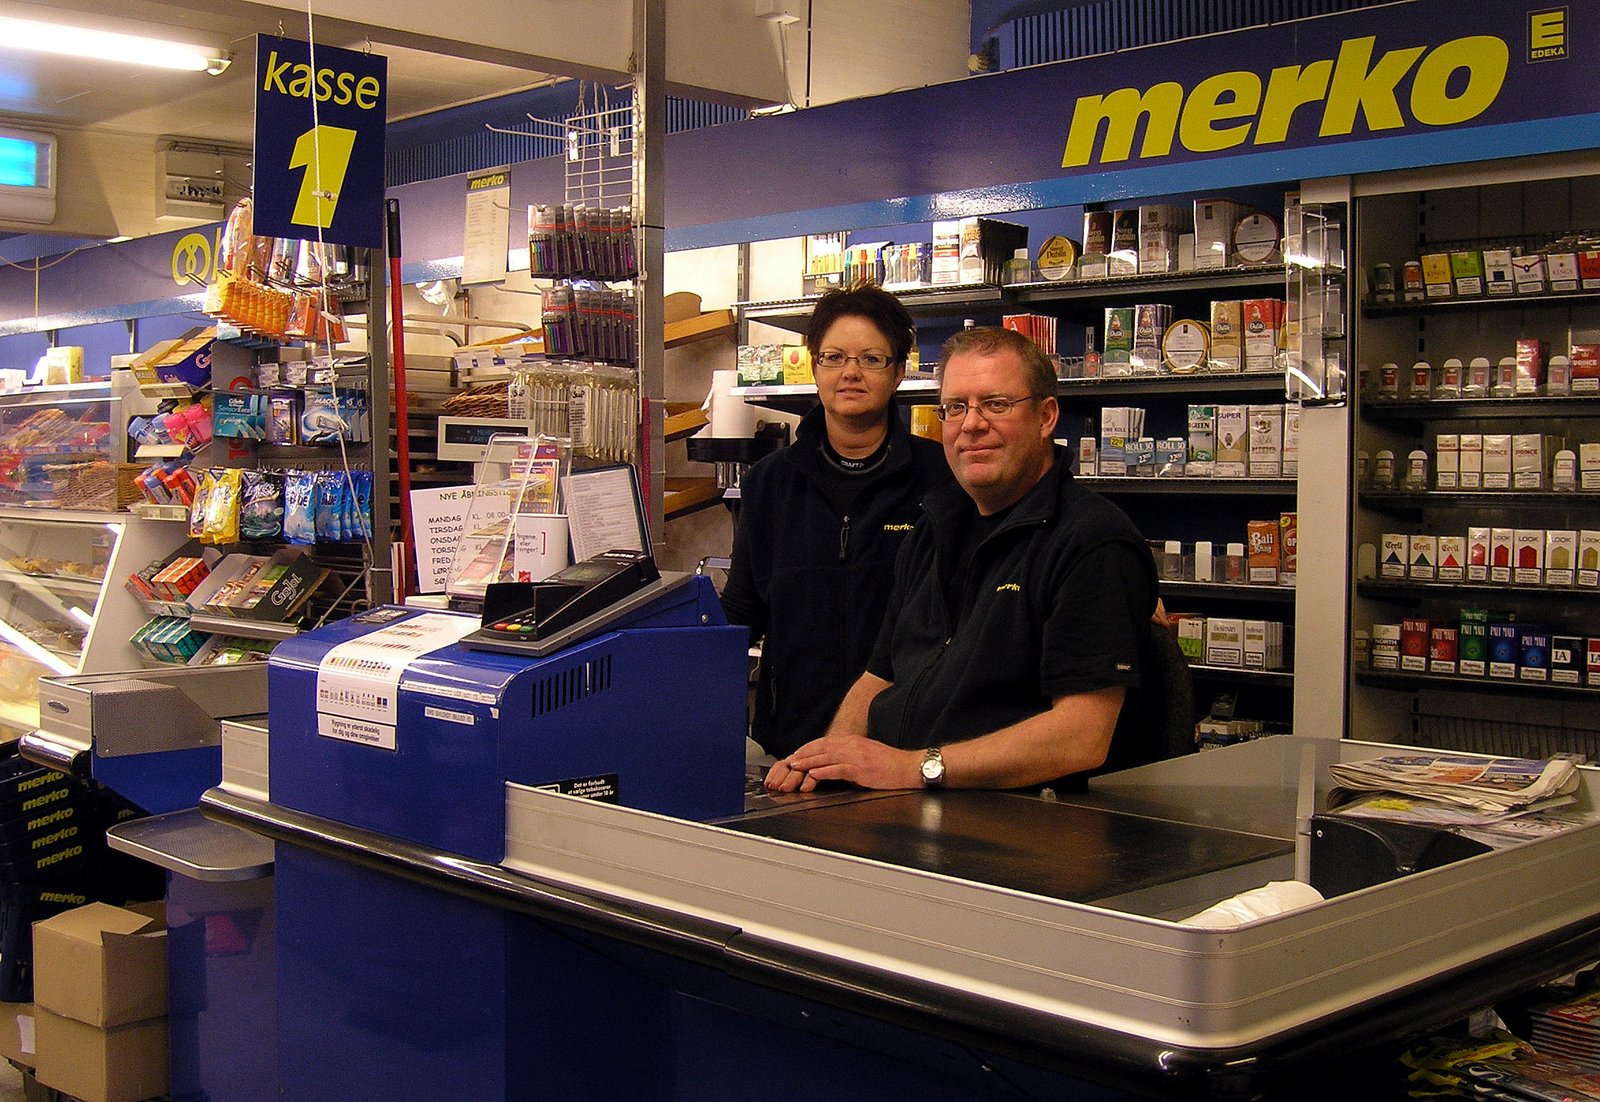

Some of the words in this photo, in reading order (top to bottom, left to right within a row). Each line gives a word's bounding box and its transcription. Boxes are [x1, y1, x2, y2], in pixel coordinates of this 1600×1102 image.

[1531, 47, 1565, 58] EDEKA
[264, 51, 380, 110] kasse
[1061, 35, 1509, 169] merko
[288, 124, 358, 229] 1
[471, 174, 504, 190] merko
[1046, 250, 1067, 259] Dublin
[1125, 443, 1143, 452] ROLL
[1156, 441, 1175, 451] ROLL
[439, 491, 458, 501] NYE
[427, 515, 462, 524] MANDAG
[429, 525, 464, 534] TIRSDAG
[1251, 532, 1274, 546] Bali
[431, 545, 467, 554] TORSDG
[1403, 621, 1414, 631] PALL
[1415, 621, 1427, 632] MALL
[1461, 624, 1472, 635] PALL
[1473, 625, 1485, 636] MALL
[1490, 626, 1501, 637] PALL
[1502, 627, 1515, 638] MALL
[1432, 630, 1442, 640] PALL
[1444, 631, 1455, 641] MALL
[1522, 636, 1533, 646] PALL
[1534, 636, 1546, 647] MALL
[18, 771, 64, 792] merko
[22, 789, 69, 811] merko
[28, 808, 74, 830] merko
[32, 826, 78, 849] merko
[37, 845, 82, 869] merko
[40, 891, 86, 905] merko
